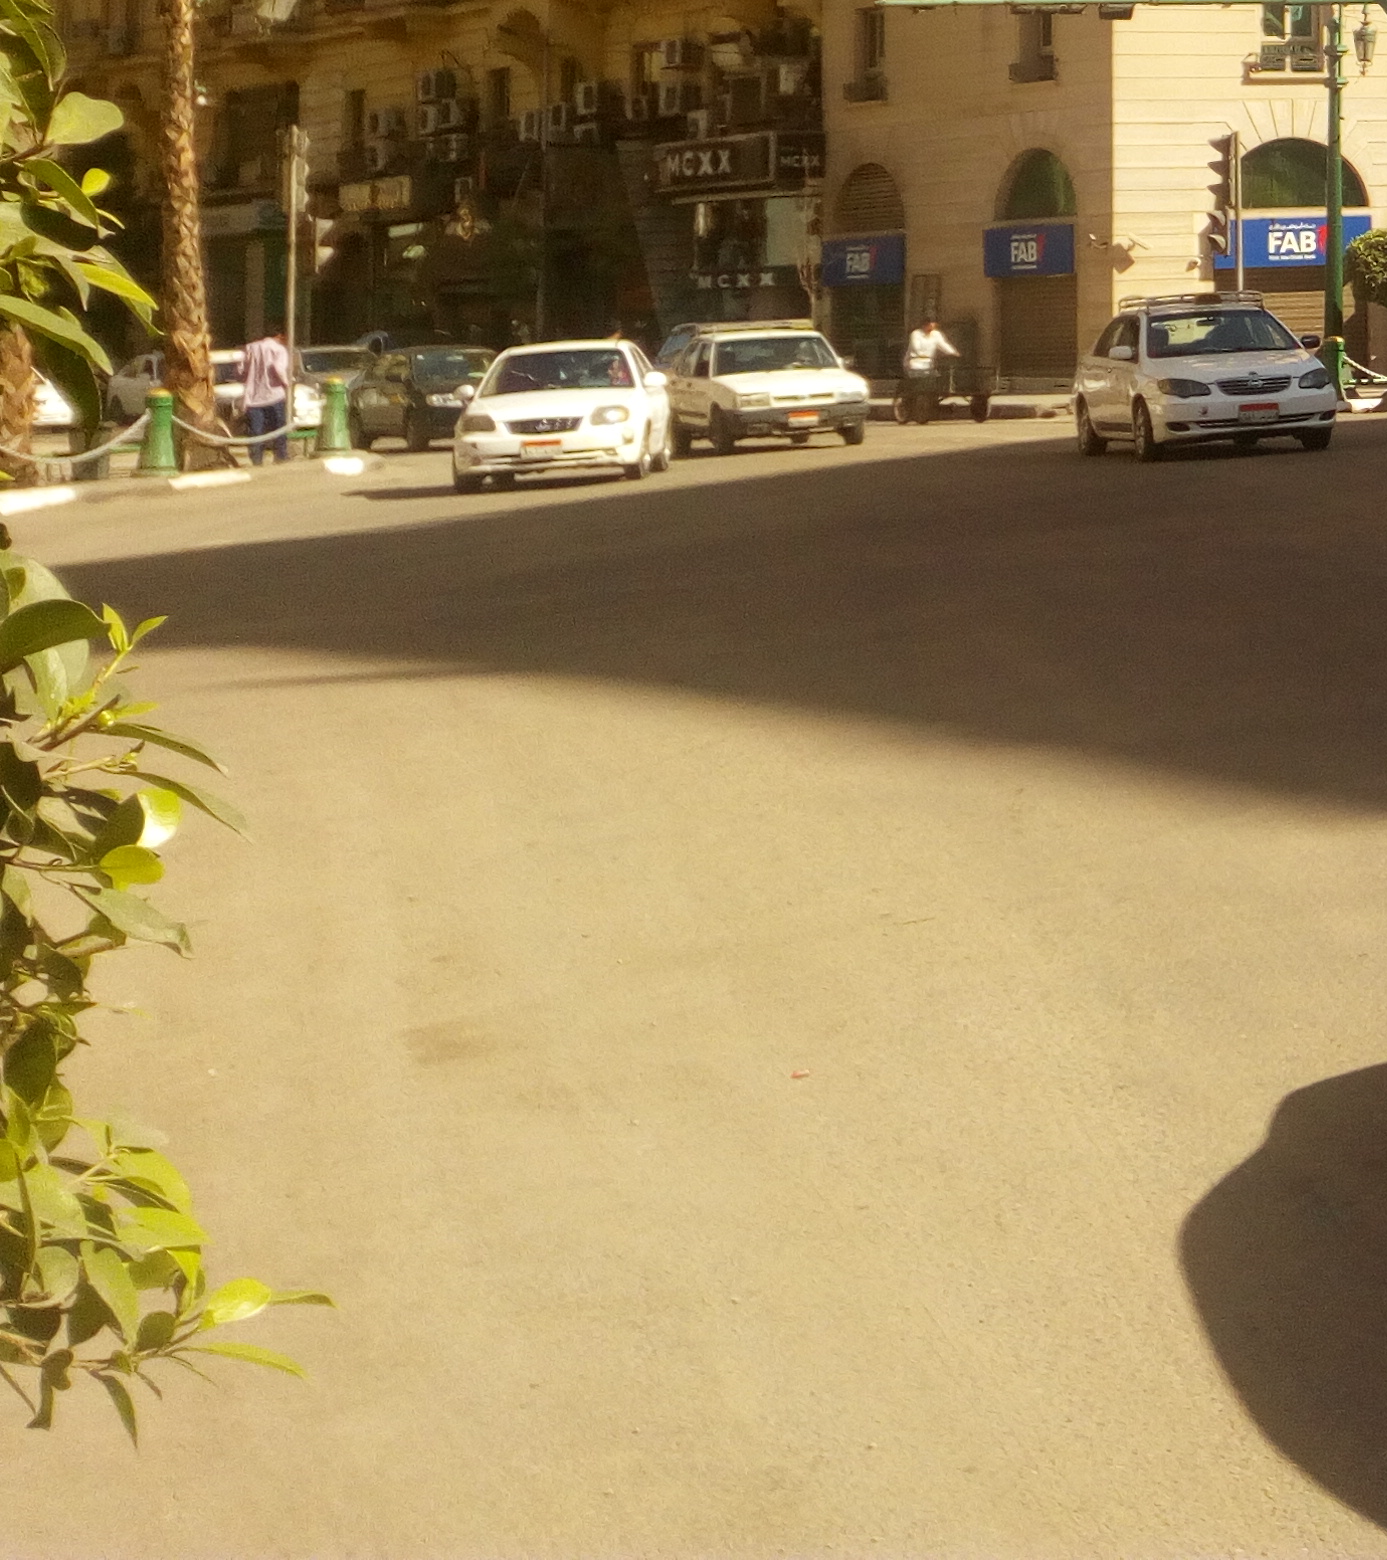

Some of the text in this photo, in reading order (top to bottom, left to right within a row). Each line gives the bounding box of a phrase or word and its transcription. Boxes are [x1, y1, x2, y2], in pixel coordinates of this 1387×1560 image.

[666, 149, 731, 176] MCXX
[1010, 241, 1037, 263] FAB
[1268, 231, 1317, 254] FAB
[846, 252, 871, 273] FAB
[698, 272, 775, 289] MCXX
